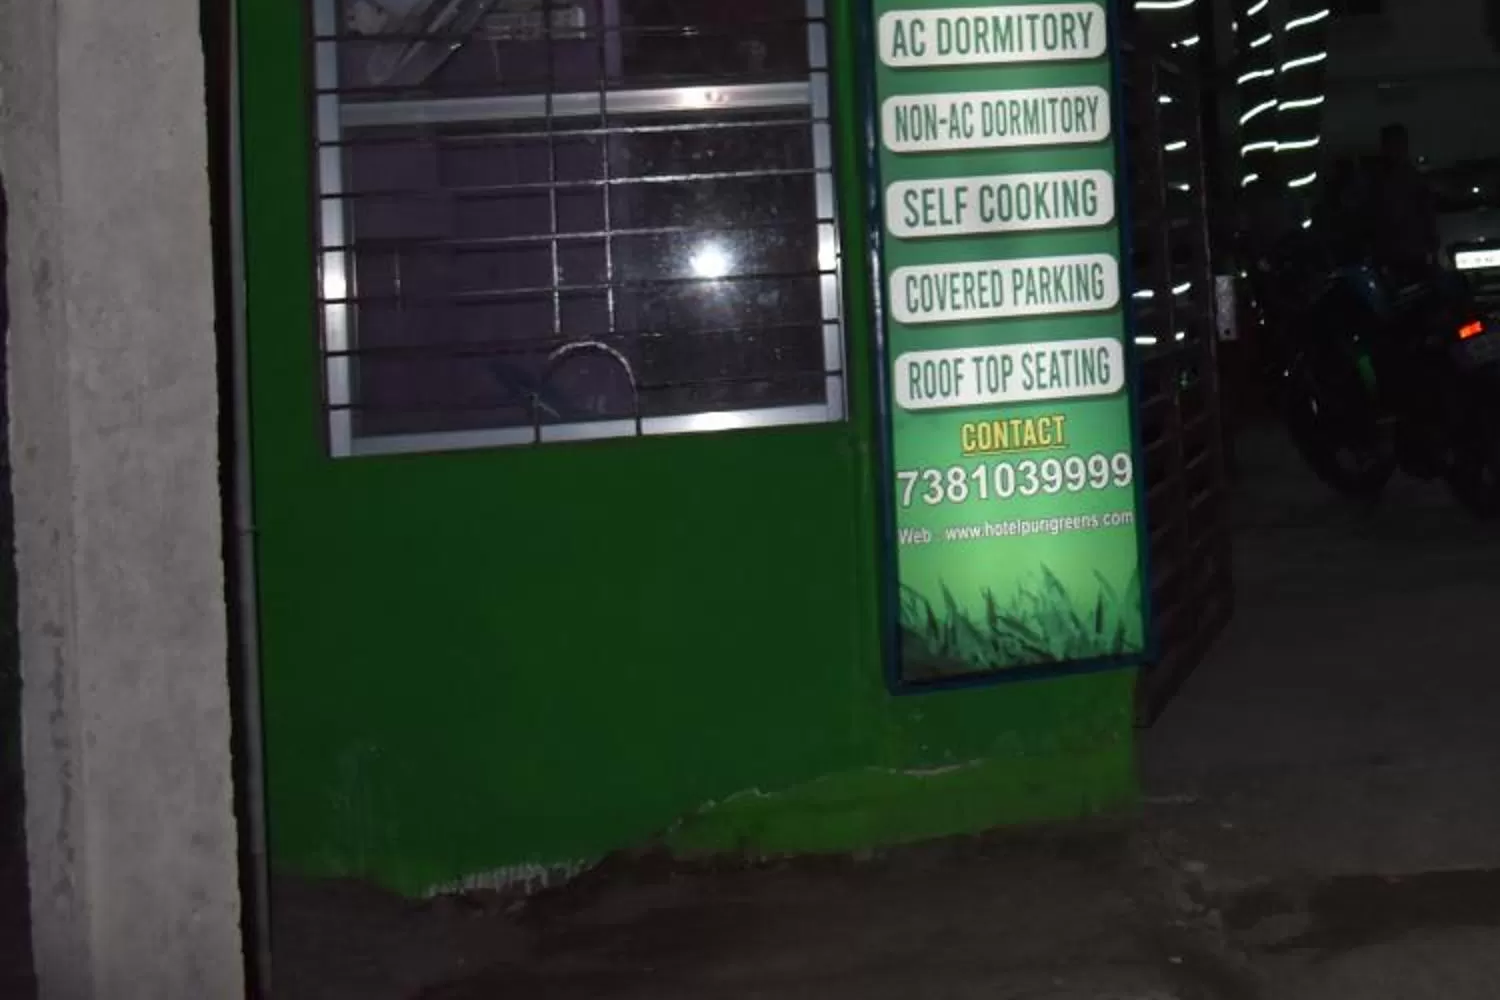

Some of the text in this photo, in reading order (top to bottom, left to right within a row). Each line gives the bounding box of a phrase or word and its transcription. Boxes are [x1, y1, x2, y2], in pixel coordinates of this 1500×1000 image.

[891, 11, 1094, 57] AC DORMITORY
[895, 95, 1099, 142] NON-AC DORMITORY
[903, 179, 1098, 228] SELF COOKING
[905, 261, 1105, 314] COVERED PARKING
[908, 346, 1111, 399] ROOF TOP SEATING
[961, 415, 1066, 451] CONTACT
[897, 452, 1133, 507] 7381039999
